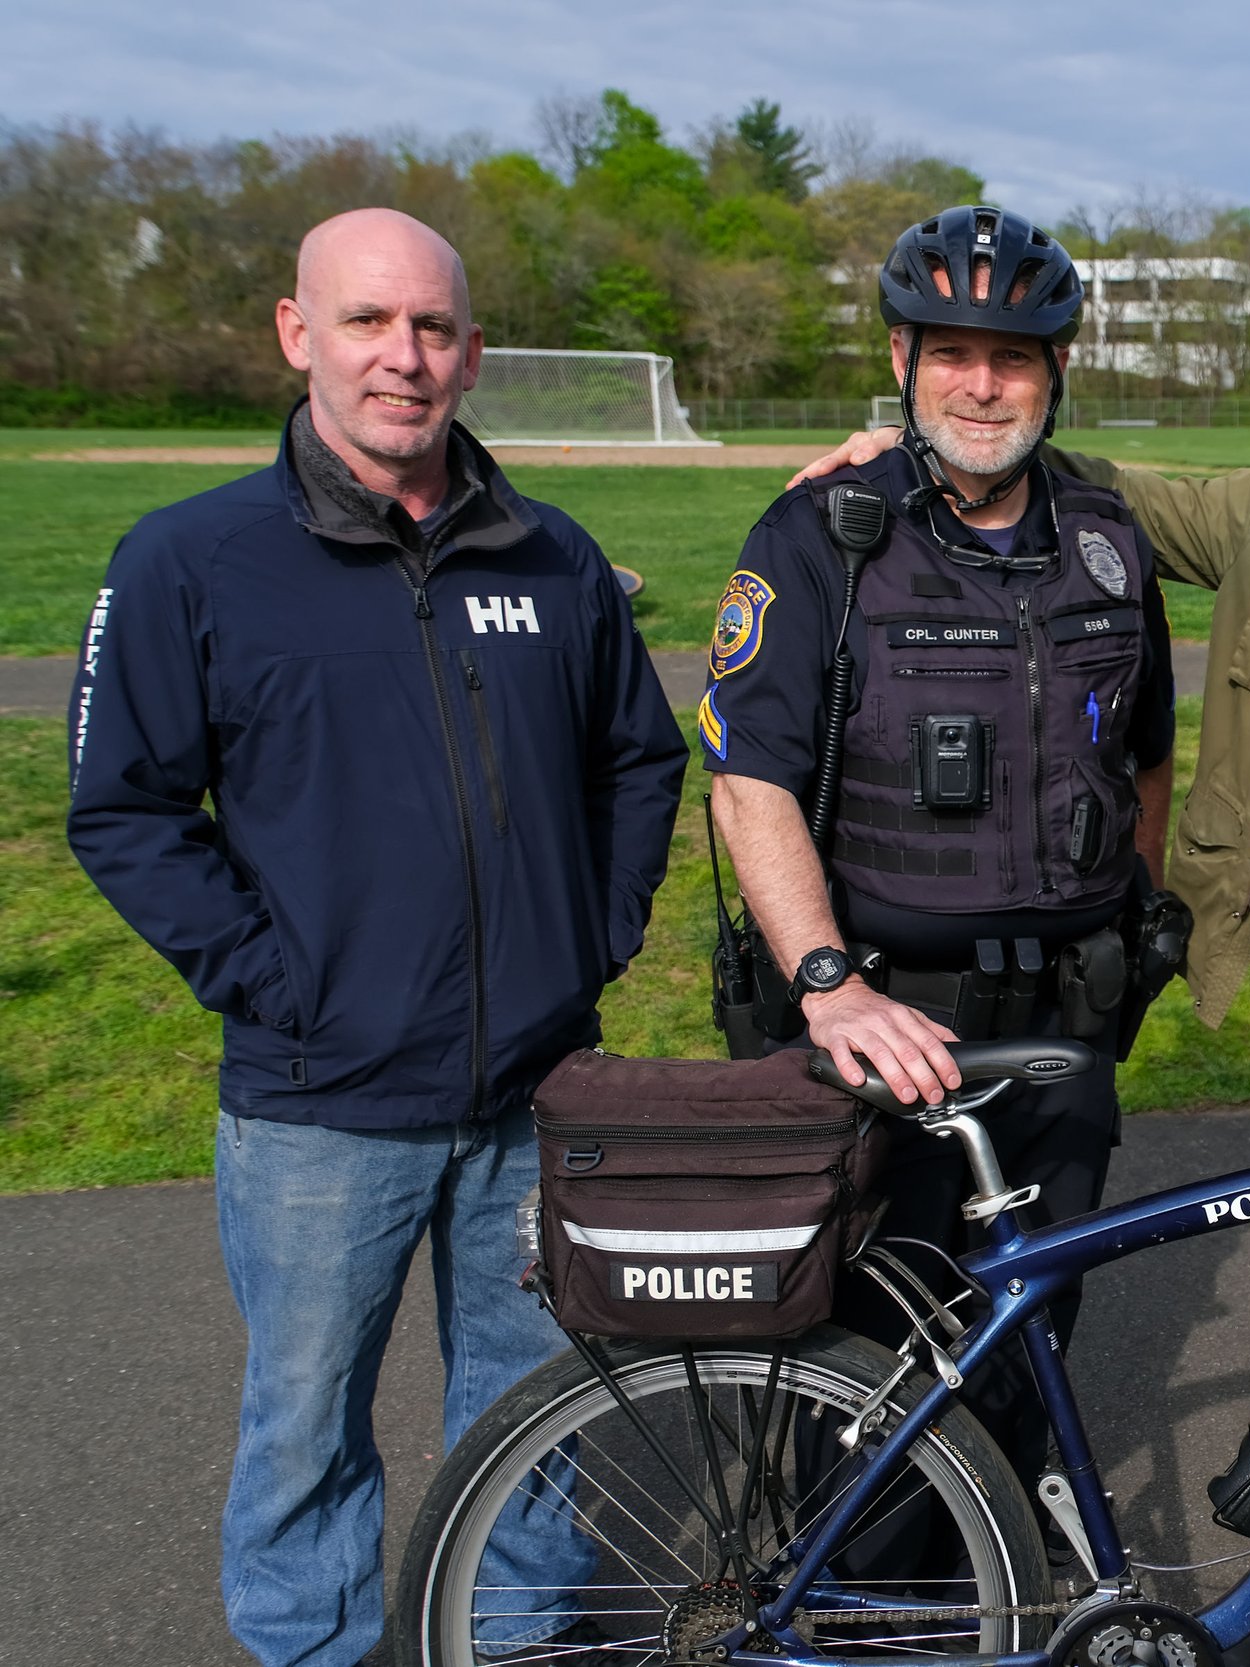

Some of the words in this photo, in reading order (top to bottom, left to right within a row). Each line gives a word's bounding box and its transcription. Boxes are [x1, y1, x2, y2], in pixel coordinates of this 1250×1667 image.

[84, 588, 114, 677] HELLY
[464, 596, 541, 634] HH
[905, 629, 938, 641] CPL.
[943, 629, 999, 641] GUNTER
[72, 686, 94, 793] HAN
[623, 1266, 753, 1300] POLICE
